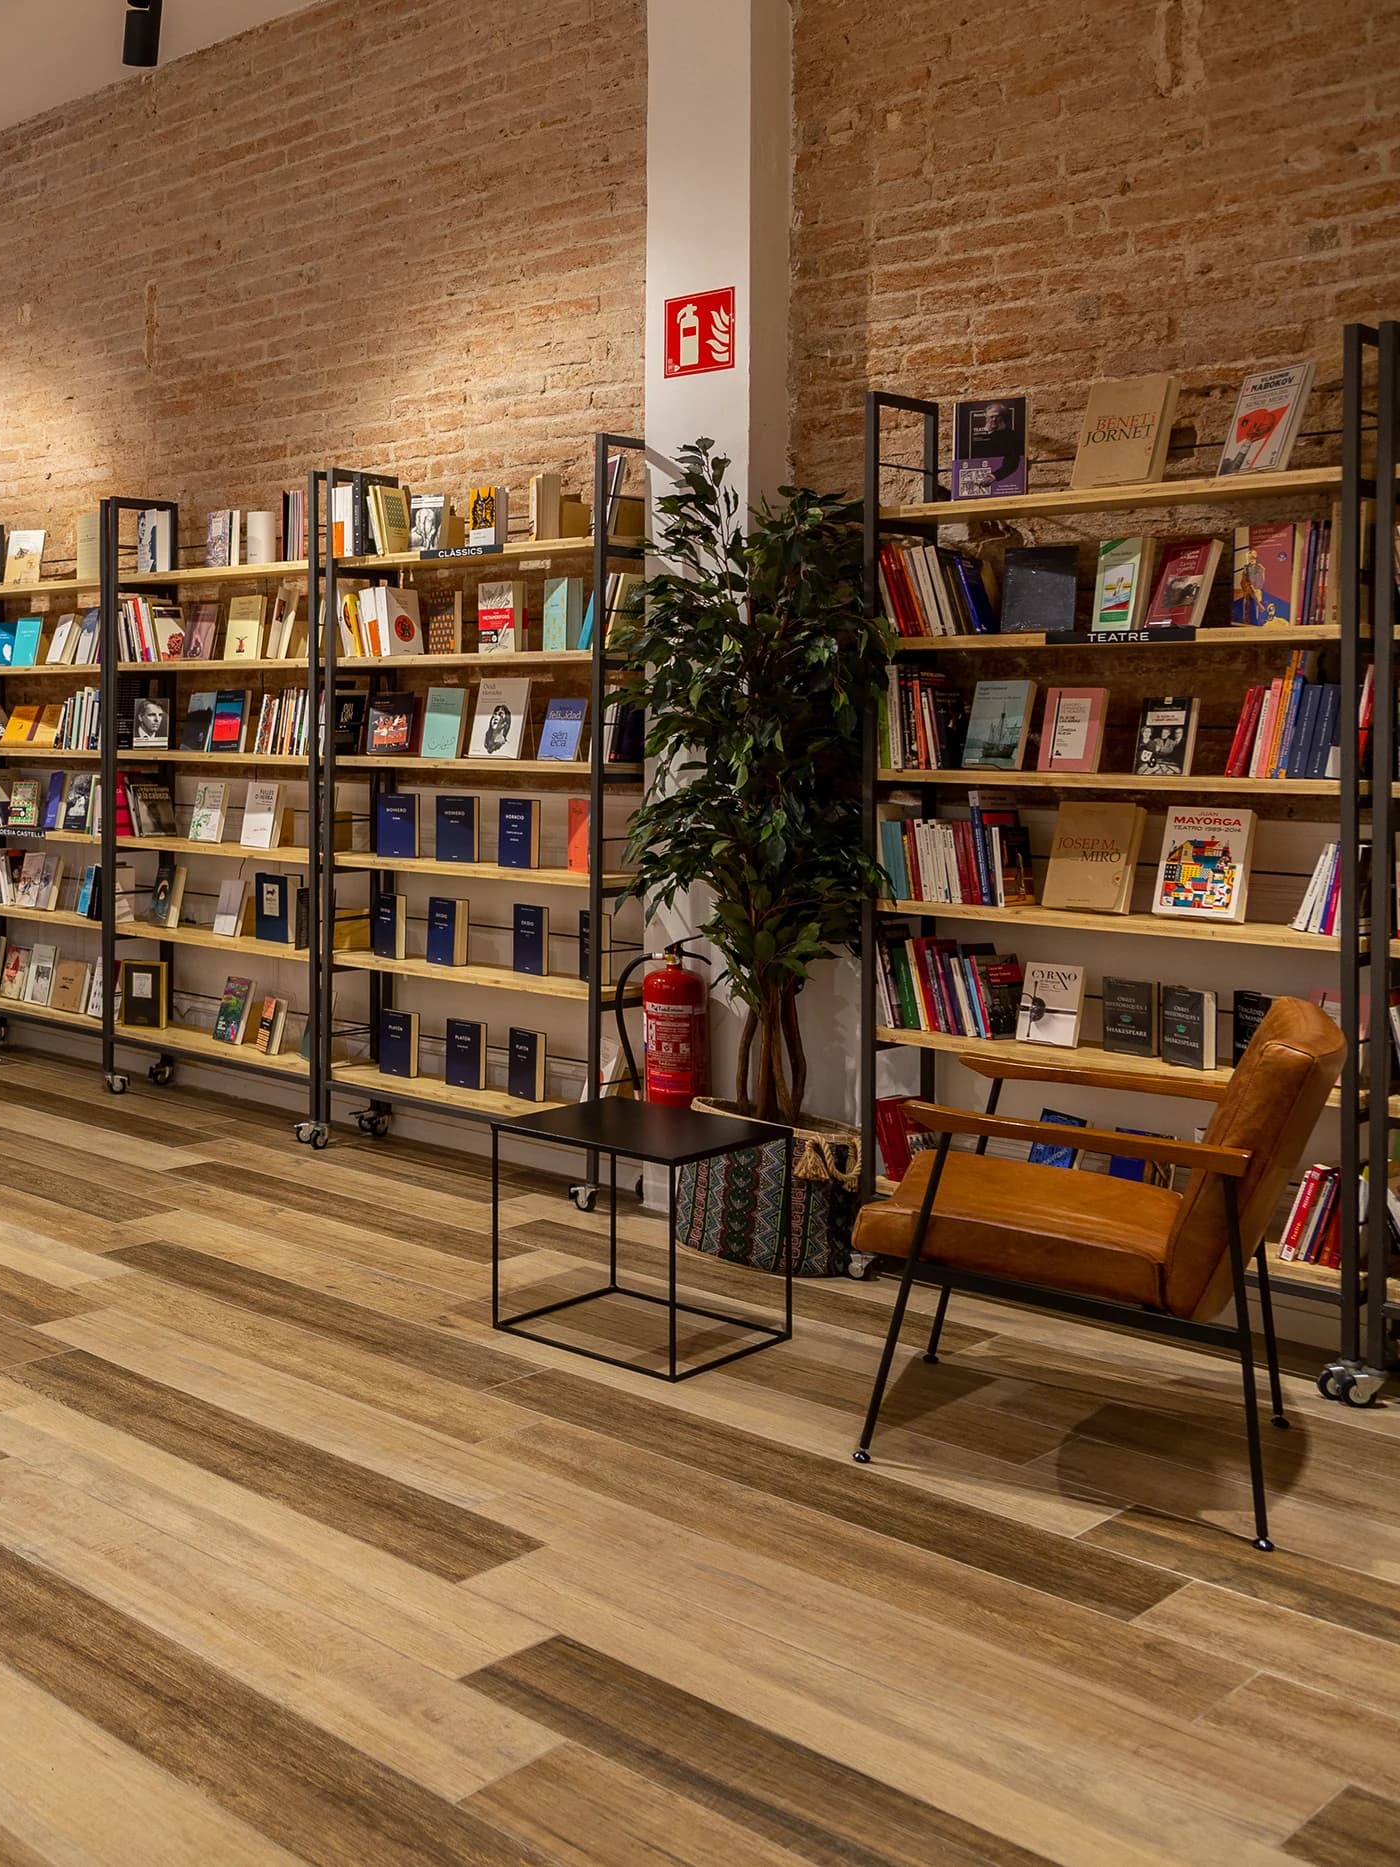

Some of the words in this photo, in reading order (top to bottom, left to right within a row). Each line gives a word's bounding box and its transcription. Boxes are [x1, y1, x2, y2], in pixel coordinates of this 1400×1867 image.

[1250, 376, 1295, 392] NABOKOV
[1096, 413, 1151, 430] BENET
[1083, 424, 1155, 447] JORNET
[1087, 632, 1150, 642] TEATRE
[549, 710, 582, 720] felicidad
[1173, 816, 1242, 826] MAYORGA
[1058, 837, 1100, 850] JOSEP
[1106, 1026, 1148, 1037] SHAKESPEARE
[1164, 1035, 1200, 1048] SHAKESPEARE
